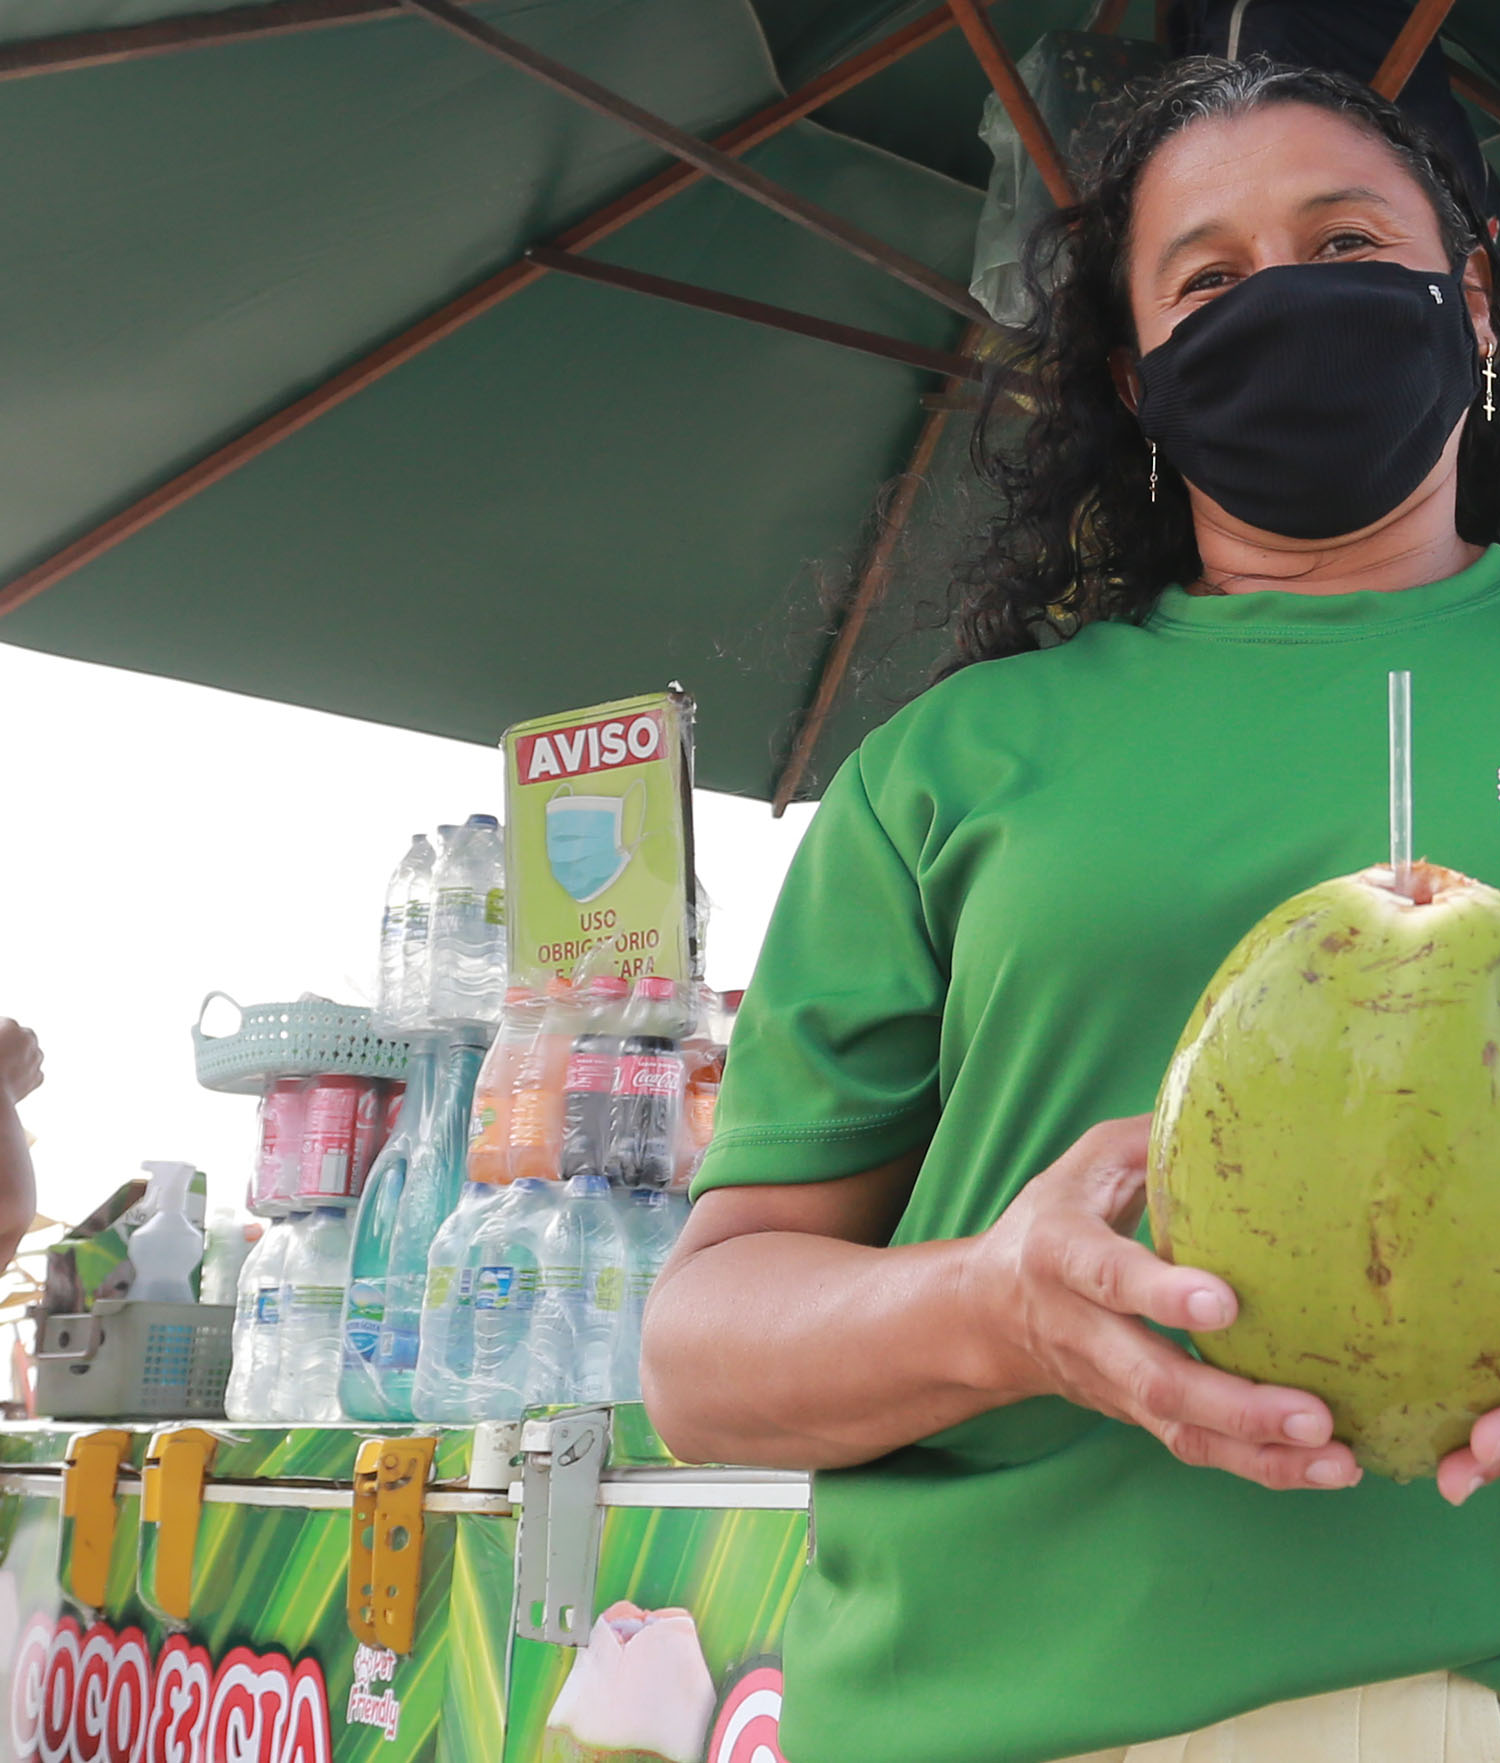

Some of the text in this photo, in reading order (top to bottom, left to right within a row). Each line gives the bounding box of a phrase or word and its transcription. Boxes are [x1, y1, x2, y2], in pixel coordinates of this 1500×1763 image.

[528, 716, 660, 780] AVISO
[580, 908, 617, 932] USO
[12, 1613, 149, 1763] COCO
[347, 1683, 400, 1741] Friendly
